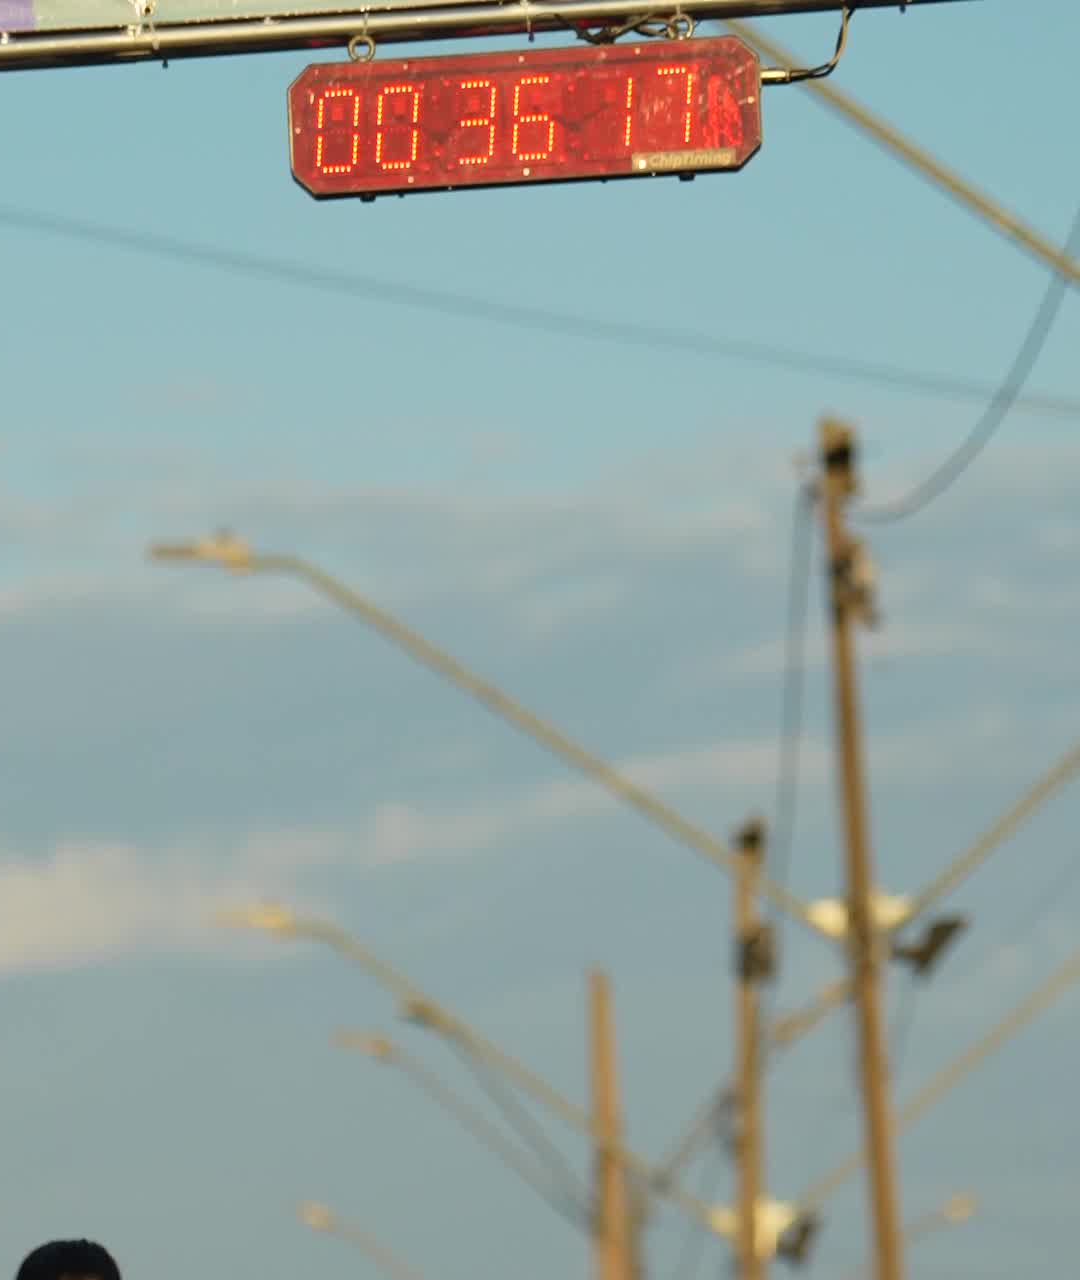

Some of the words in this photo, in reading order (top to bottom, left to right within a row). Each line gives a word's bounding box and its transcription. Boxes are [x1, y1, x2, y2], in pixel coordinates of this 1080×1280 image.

[317, 87, 419, 173] 00
[458, 76, 555, 165] 36
[624, 67, 694, 147] 17
